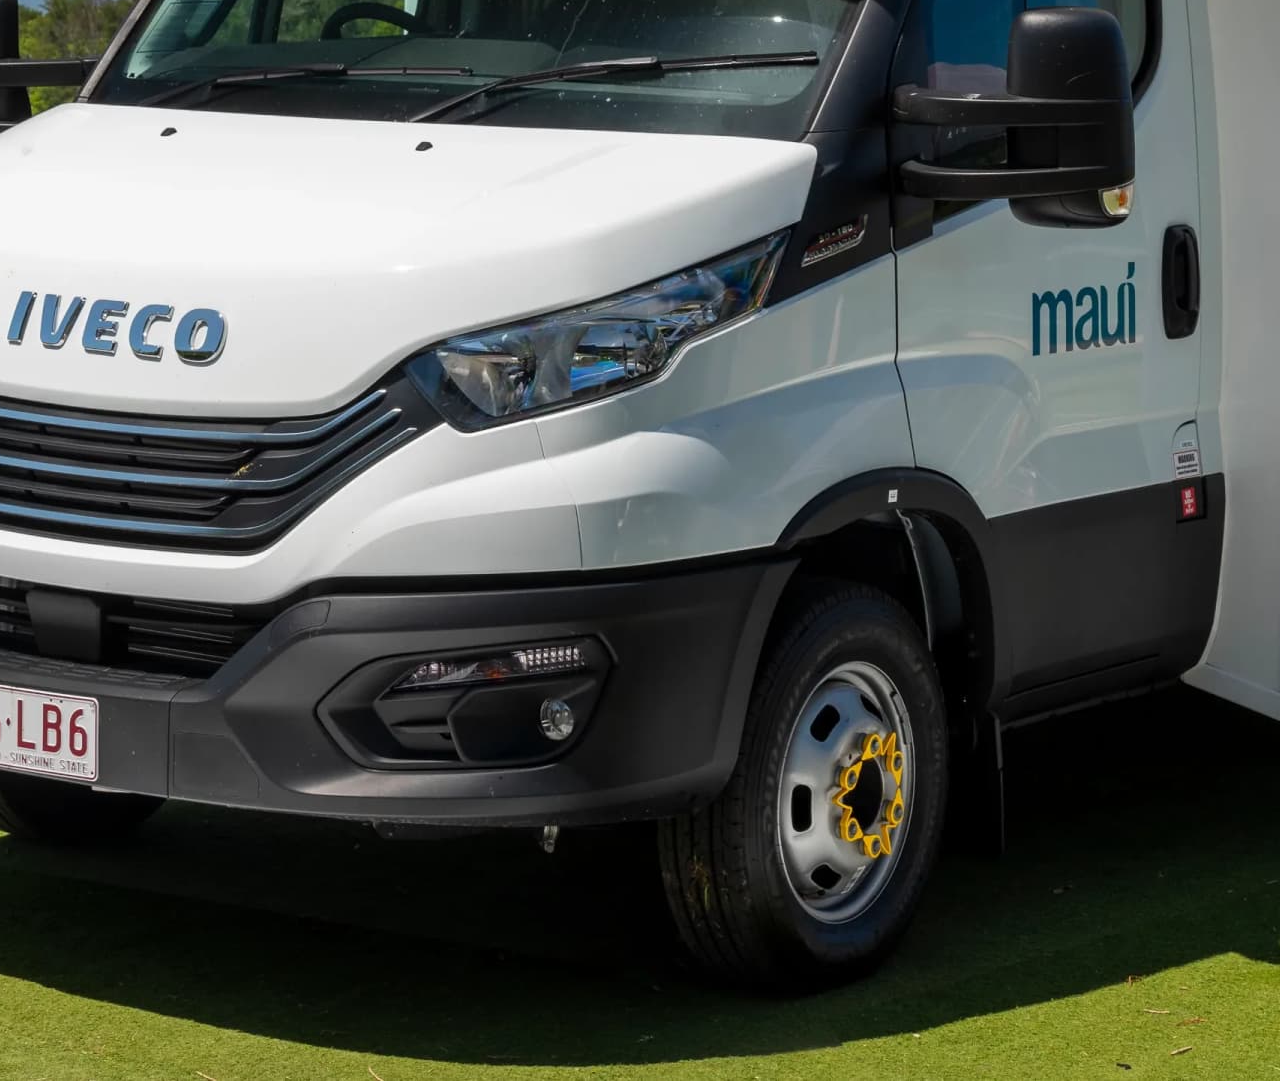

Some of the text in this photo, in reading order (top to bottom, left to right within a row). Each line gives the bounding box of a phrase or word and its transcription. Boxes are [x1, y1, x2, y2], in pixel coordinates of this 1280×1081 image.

[7, 291, 228, 367] IVECO
[10, 752, 54, 770] SUNSHINE
[60, 760, 89, 774] STATE
